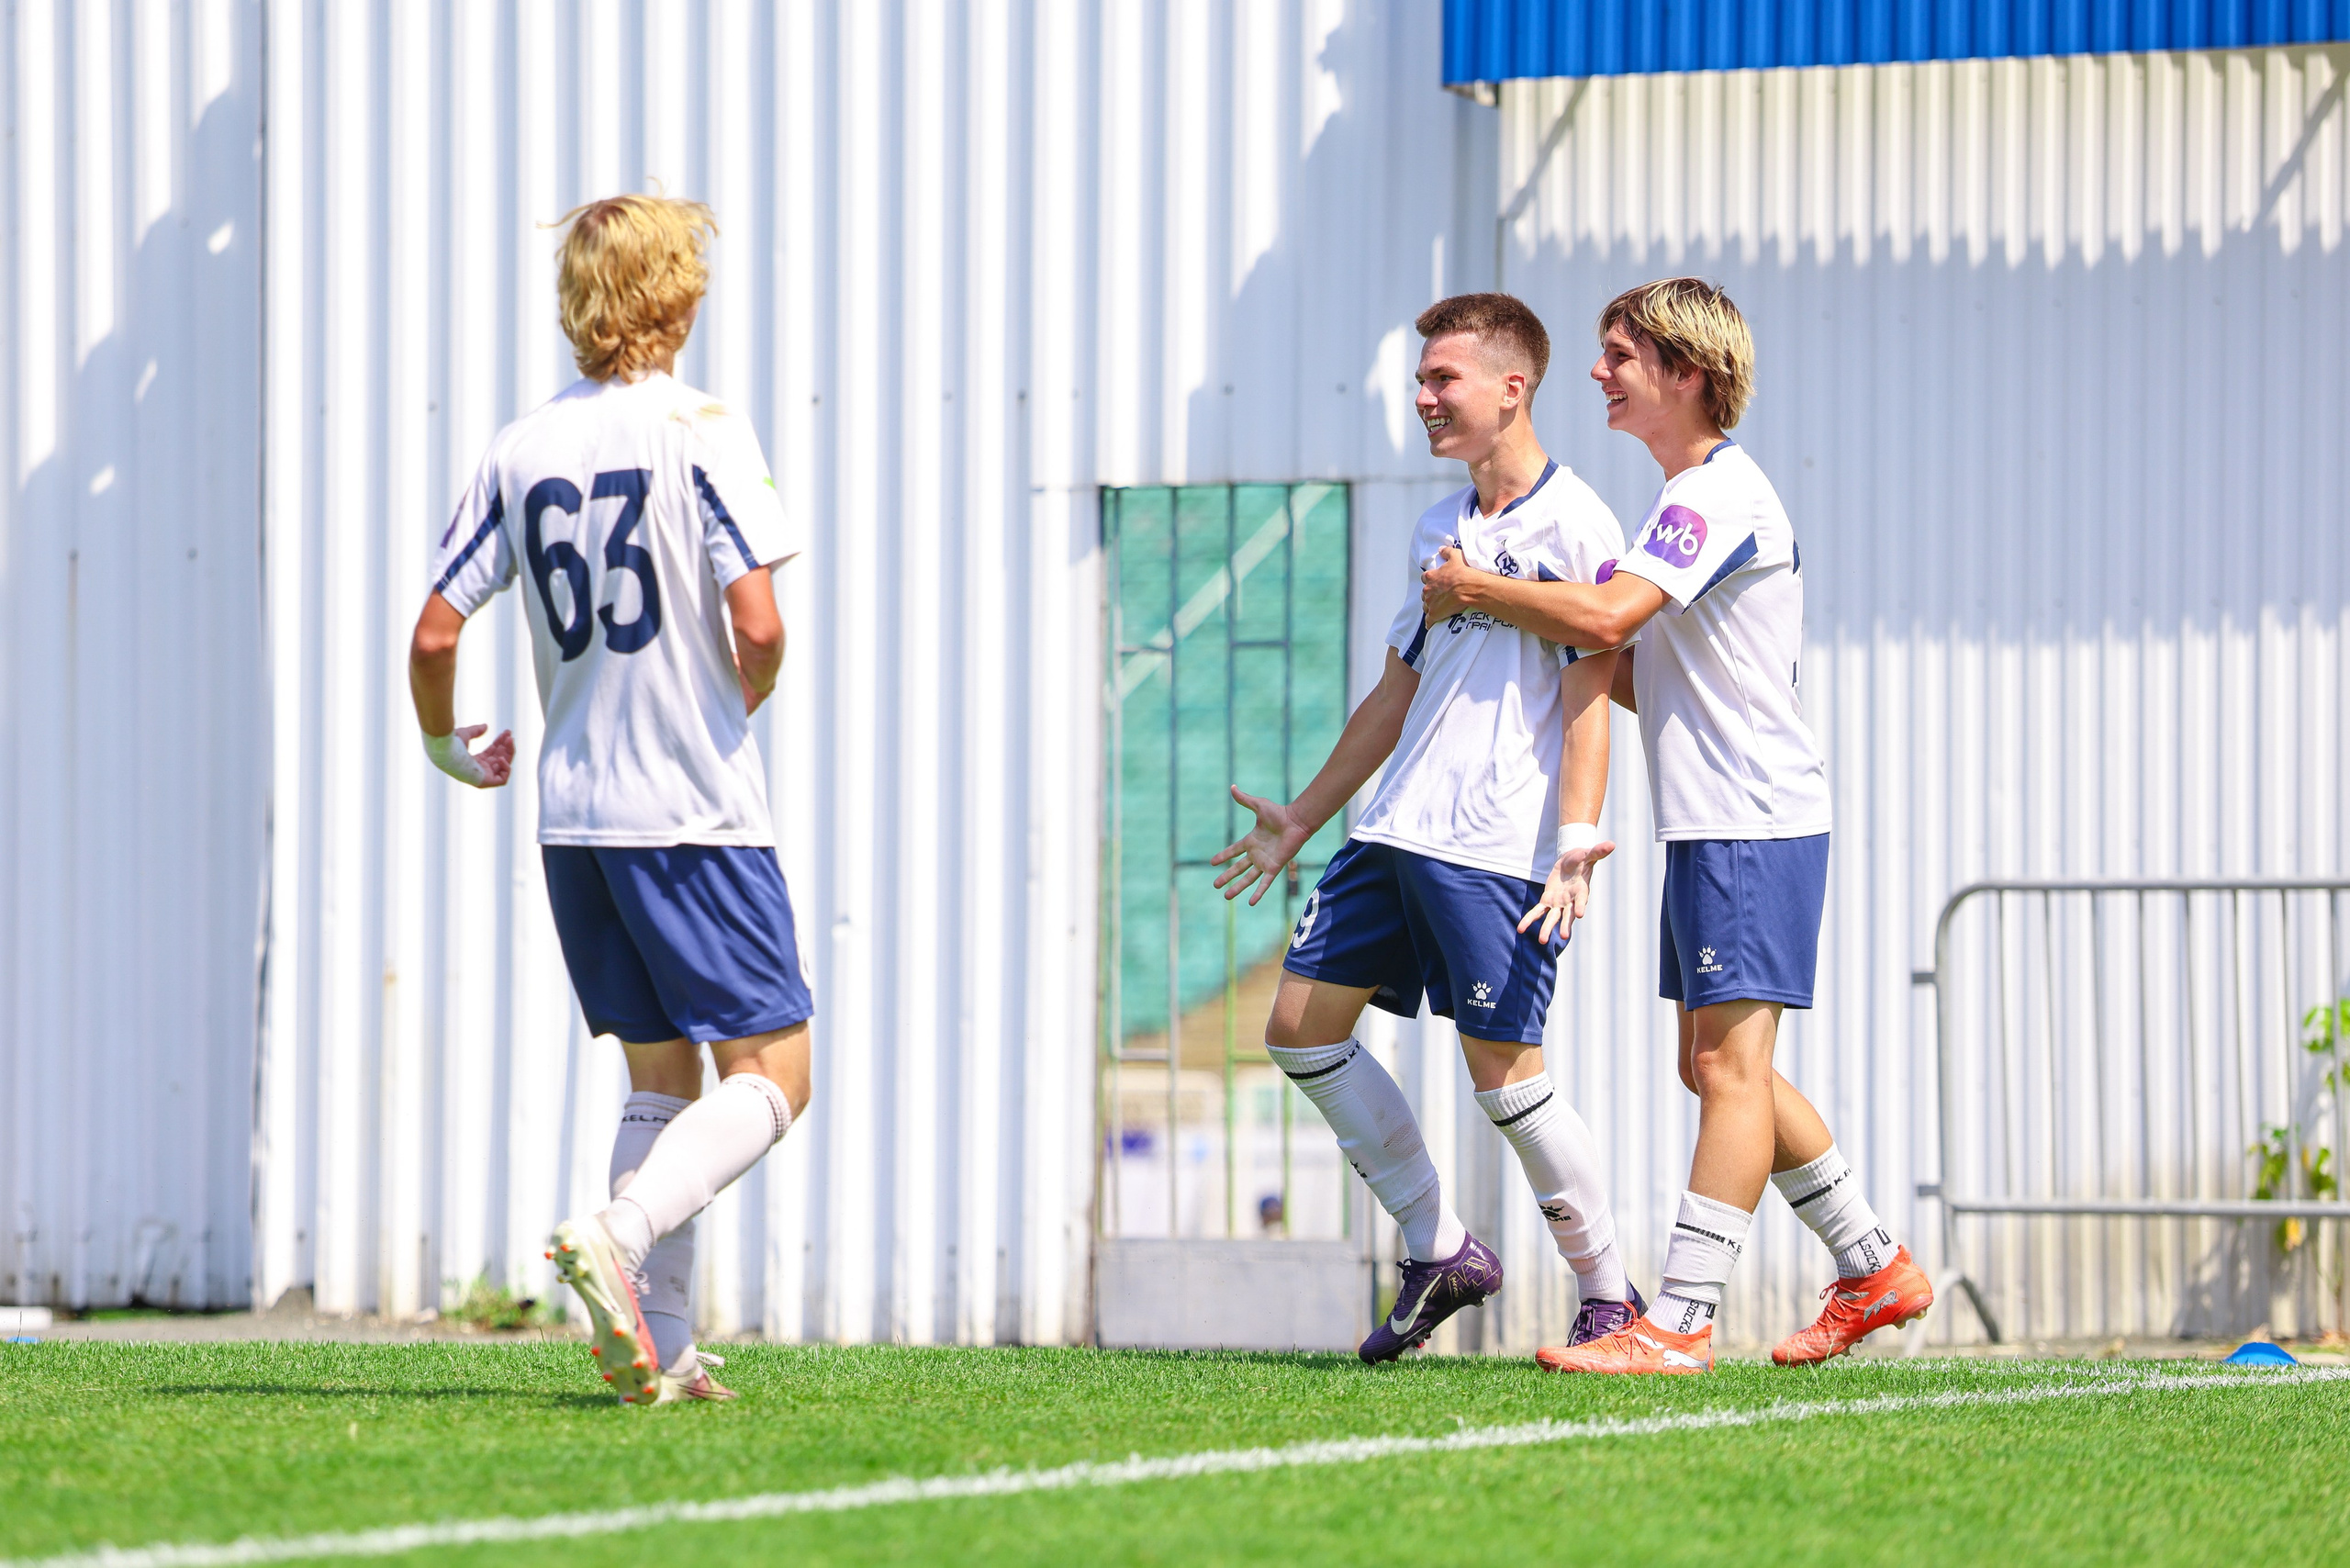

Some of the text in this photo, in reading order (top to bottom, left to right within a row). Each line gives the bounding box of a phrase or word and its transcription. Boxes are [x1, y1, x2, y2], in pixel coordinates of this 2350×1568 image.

[1656, 522, 1699, 556] wb
[524, 468, 662, 663] 63
[1291, 888, 1319, 948] 9
[1696, 965, 1723, 974] KELME
[1467, 998, 1497, 1009] KELME
[621, 1114, 672, 1125] KELM
[1678, 1300, 1700, 1335] SOCKS
